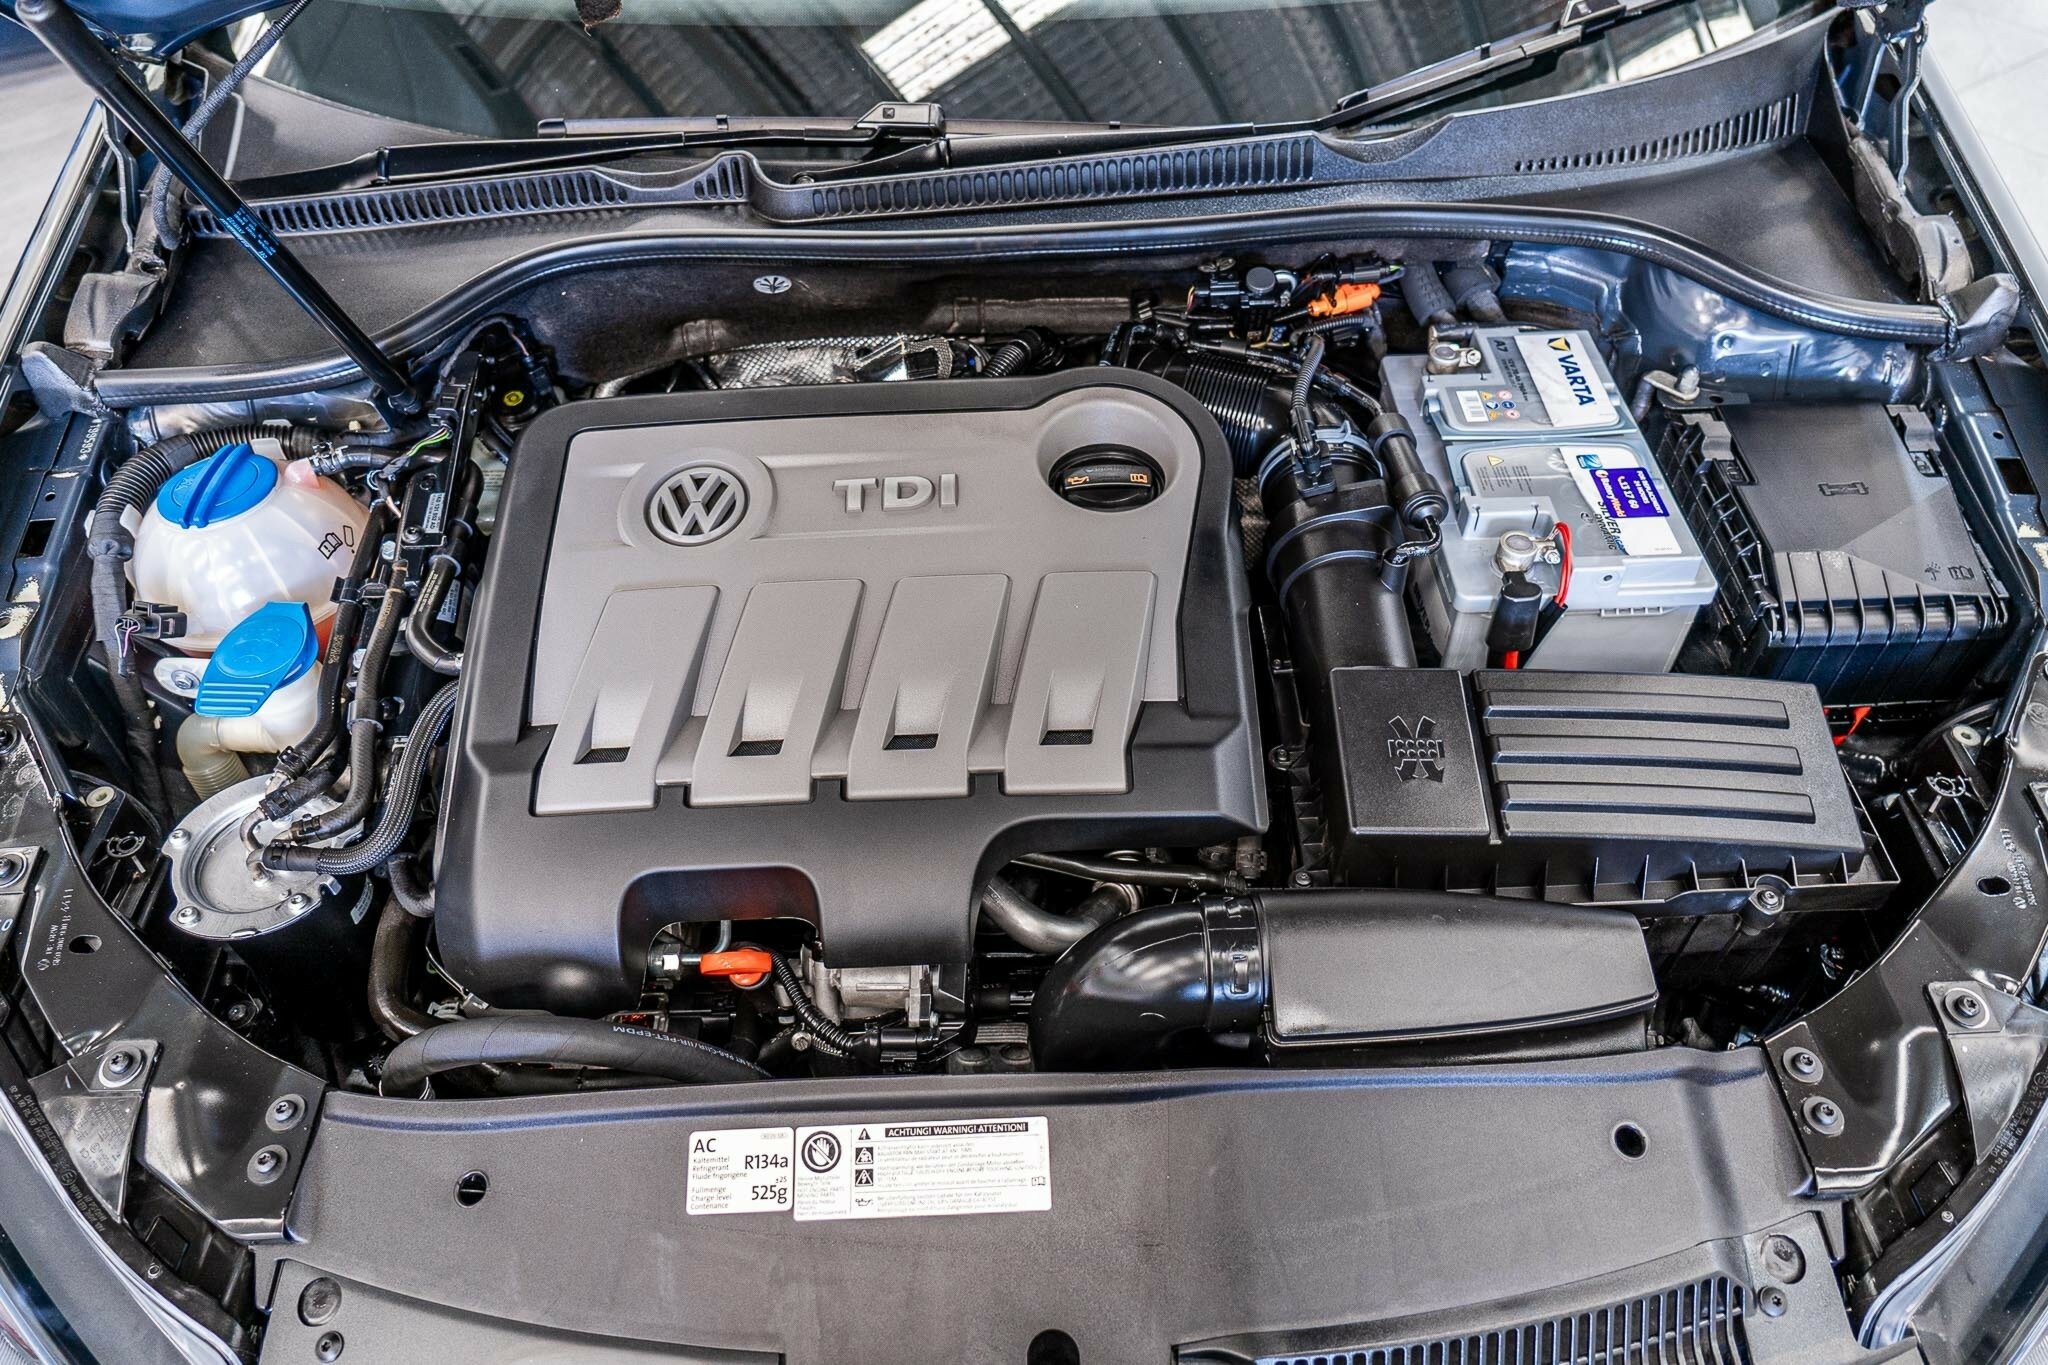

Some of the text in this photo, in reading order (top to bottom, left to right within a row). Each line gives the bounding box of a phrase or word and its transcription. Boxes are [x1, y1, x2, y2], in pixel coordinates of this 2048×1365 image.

[1494, 341, 1508, 351] A7
[1558, 354, 1595, 407] VARTA
[833, 473, 959, 513] TDI
[1636, 487, 1650, 503] HOURS
[1641, 480, 1663, 513] REPLACEMENT
[1628, 500, 1640, 509] 60
[1594, 514, 1618, 550] DYNAMIC
[888, 1123, 1026, 1137] ACHTUNG! WARNING! ATTENTION!
[694, 1138, 716, 1153] AC
[693, 1165, 729, 1173] Refrigerant
[745, 1154, 788, 1169] R134a
[691, 1195, 714, 1203] Charge
[751, 1184, 787, 1204] 525g
